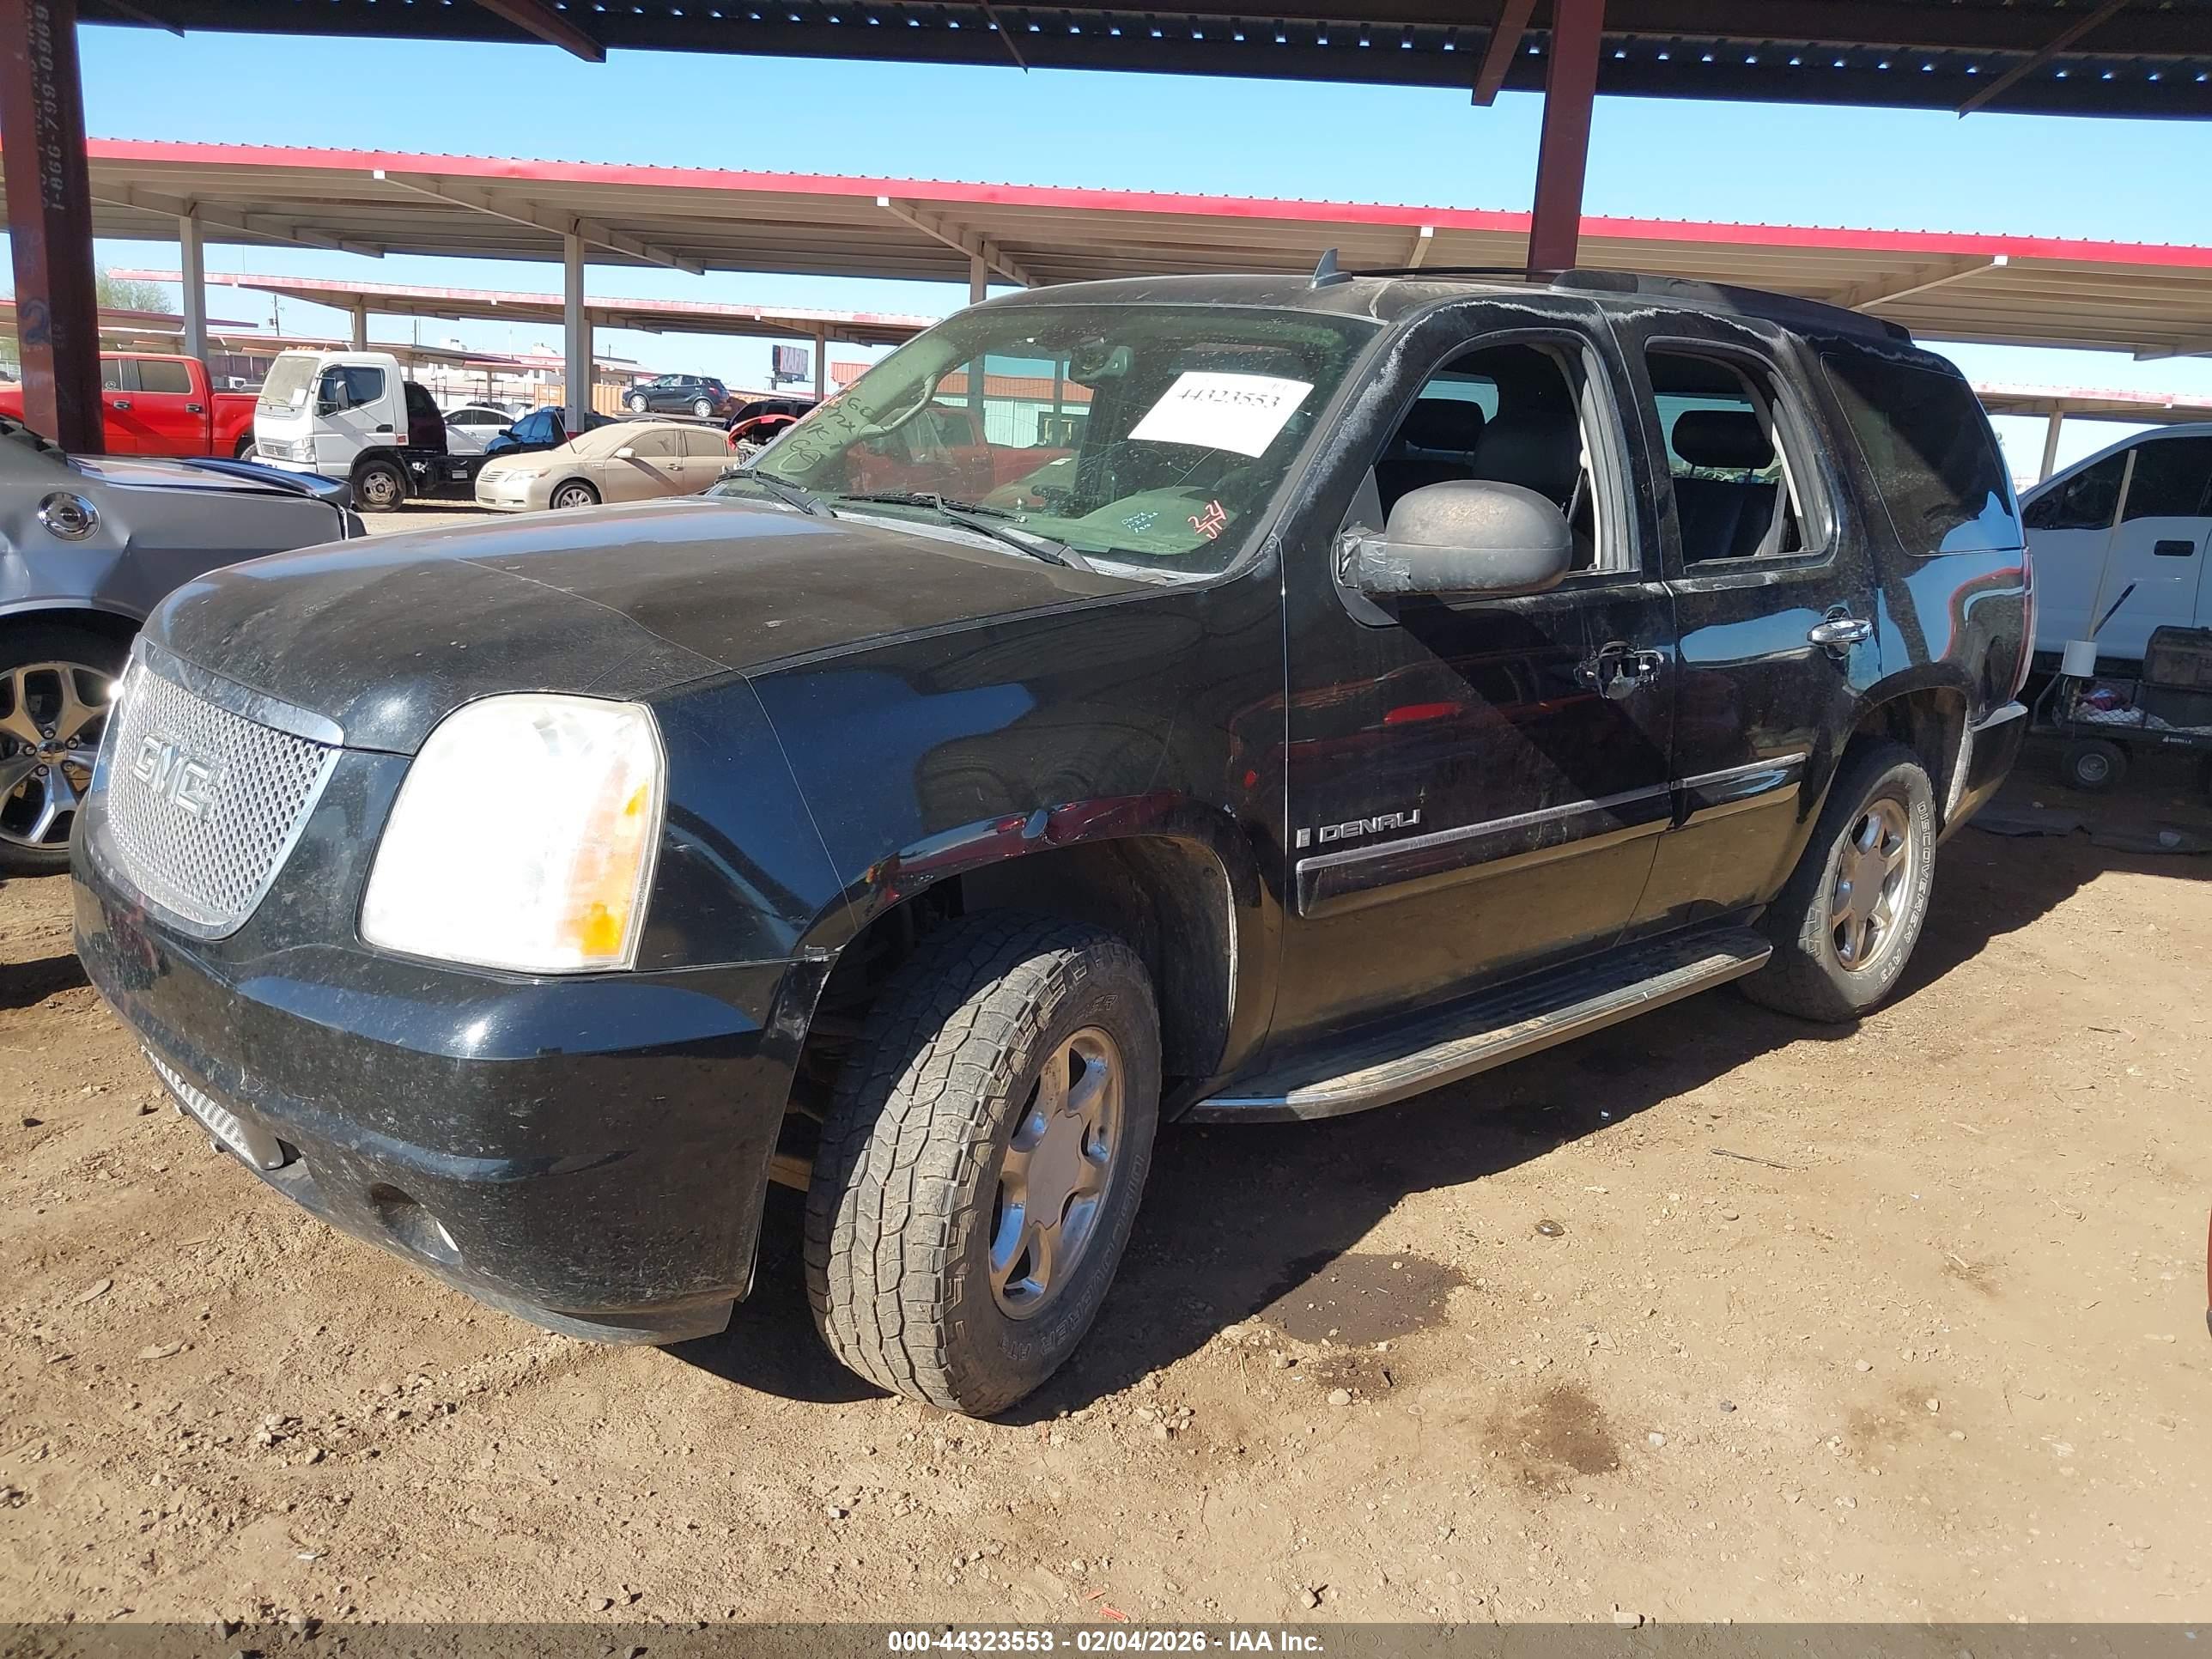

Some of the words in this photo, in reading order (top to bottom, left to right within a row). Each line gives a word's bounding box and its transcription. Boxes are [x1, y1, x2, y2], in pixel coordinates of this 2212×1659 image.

[1177, 389, 1280, 409] 44323553
[132, 730, 218, 823] GMC
[1319, 809, 1421, 843] DENALI
[1904, 800, 1931, 944] DISCOVERER
[1881, 947, 1903, 983] AT3
